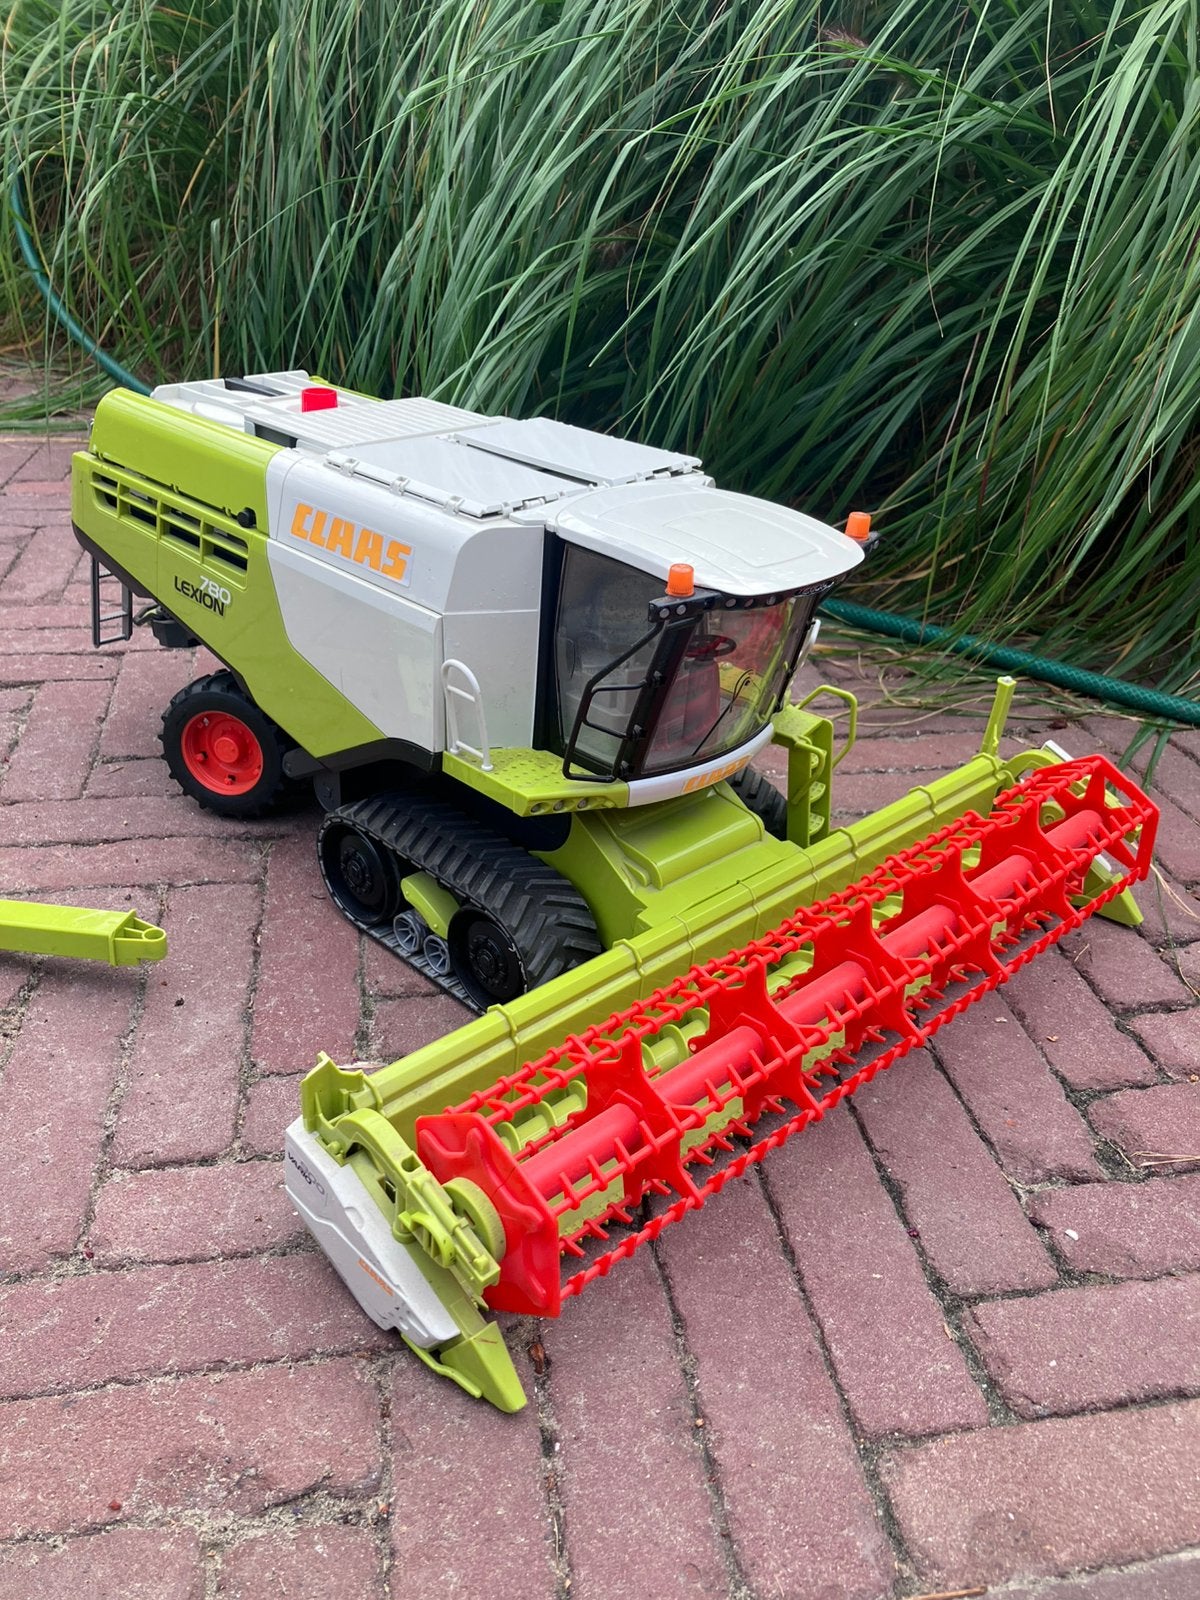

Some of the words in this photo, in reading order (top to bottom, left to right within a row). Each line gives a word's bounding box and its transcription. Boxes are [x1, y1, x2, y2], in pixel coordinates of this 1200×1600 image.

[290, 502, 411, 580] CLAAS
[174, 576, 225, 616] LEXION
[199, 575, 231, 604] 780
